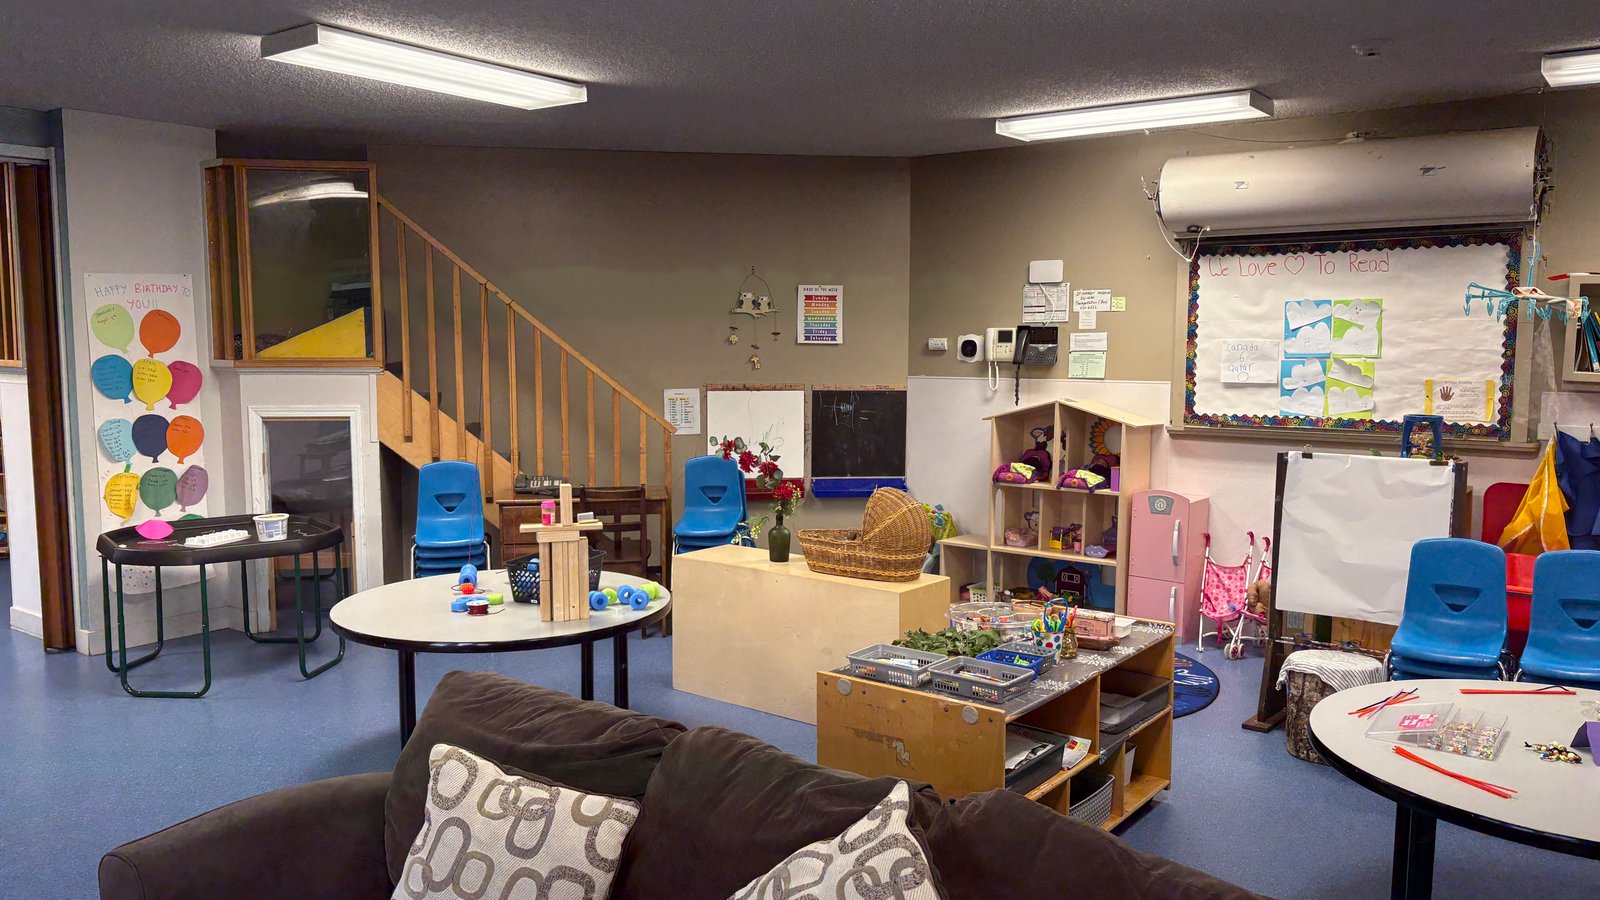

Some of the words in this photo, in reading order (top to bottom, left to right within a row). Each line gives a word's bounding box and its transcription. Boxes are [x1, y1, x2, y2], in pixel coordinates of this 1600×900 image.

[1208, 257, 1229, 277] We
[1239, 256, 1277, 276] Love
[1314, 254, 1336, 275] To
[1349, 253, 1390, 273] Read
[95, 284, 127, 298] HAPPY
[134, 283, 178, 294] BIRTHDAY
[182, 286, 191, 297] TO
[1228, 363, 1256, 373] Qatar
